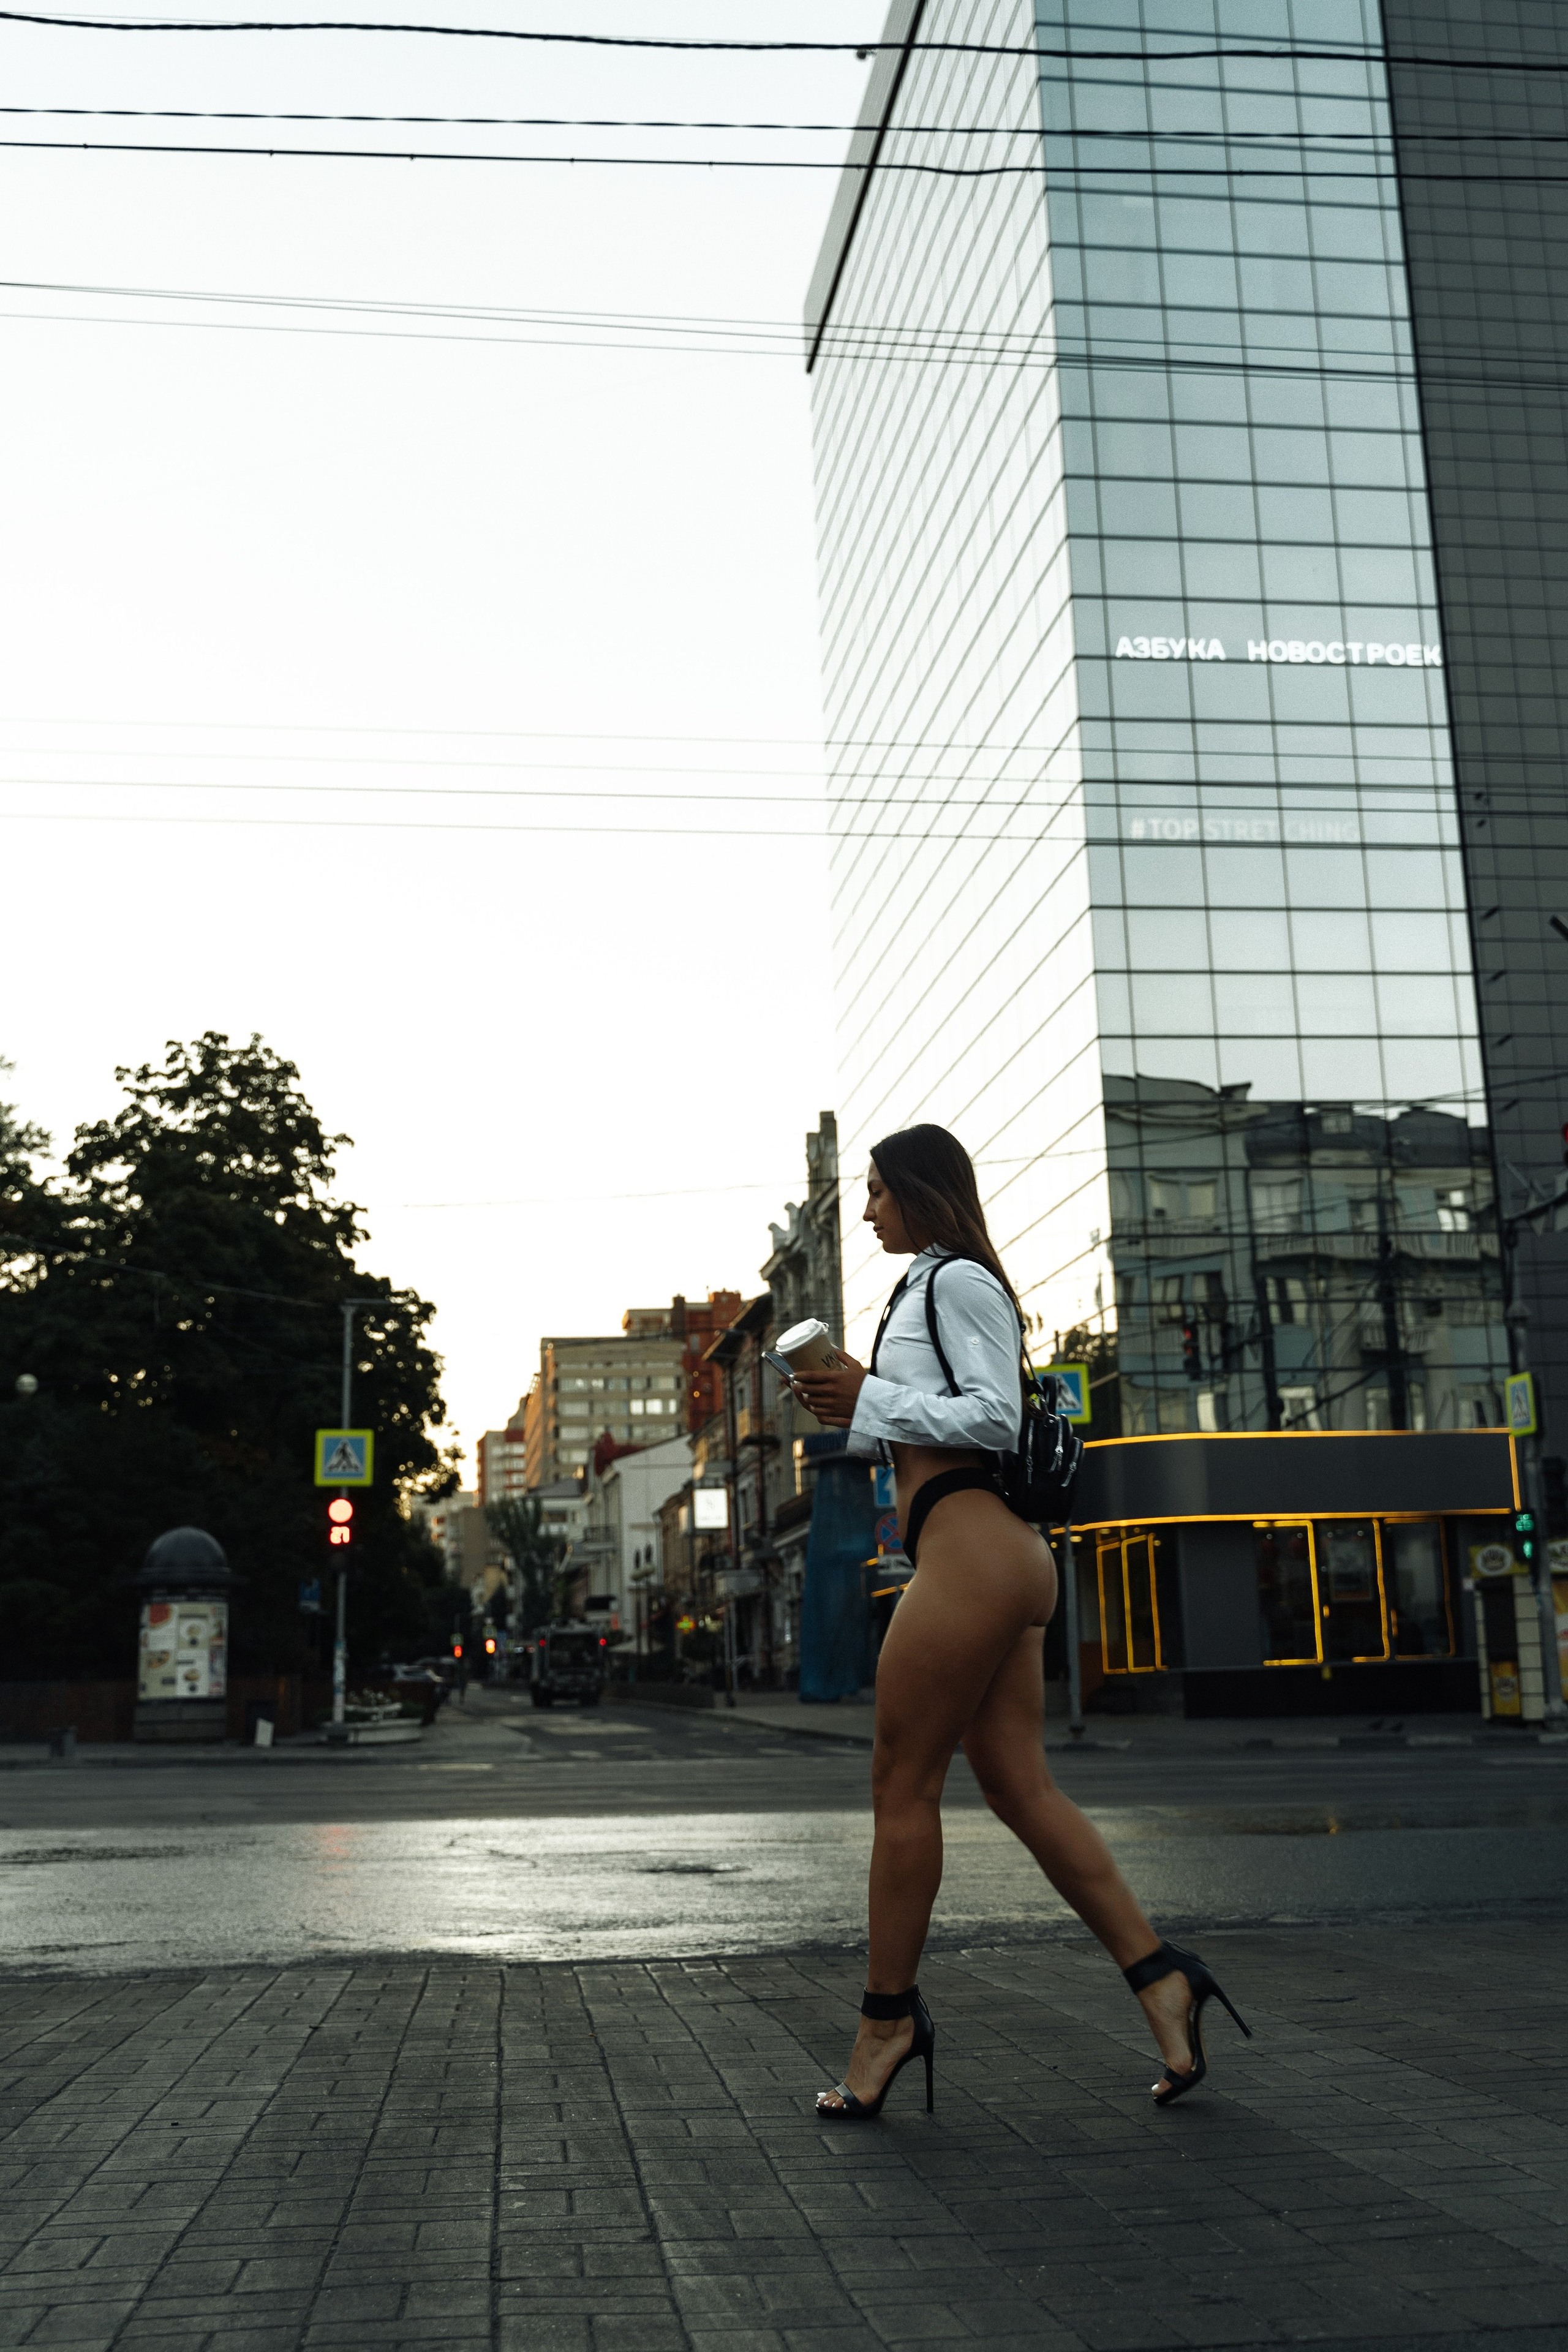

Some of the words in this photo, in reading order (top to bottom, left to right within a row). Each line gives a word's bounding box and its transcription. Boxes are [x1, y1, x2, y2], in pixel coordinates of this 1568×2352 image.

[1115, 636, 1226, 660] АЗБУКА
[1247, 639, 1442, 666] НОВОСТРОЕК
[1129, 817, 1197, 840] #TOP
